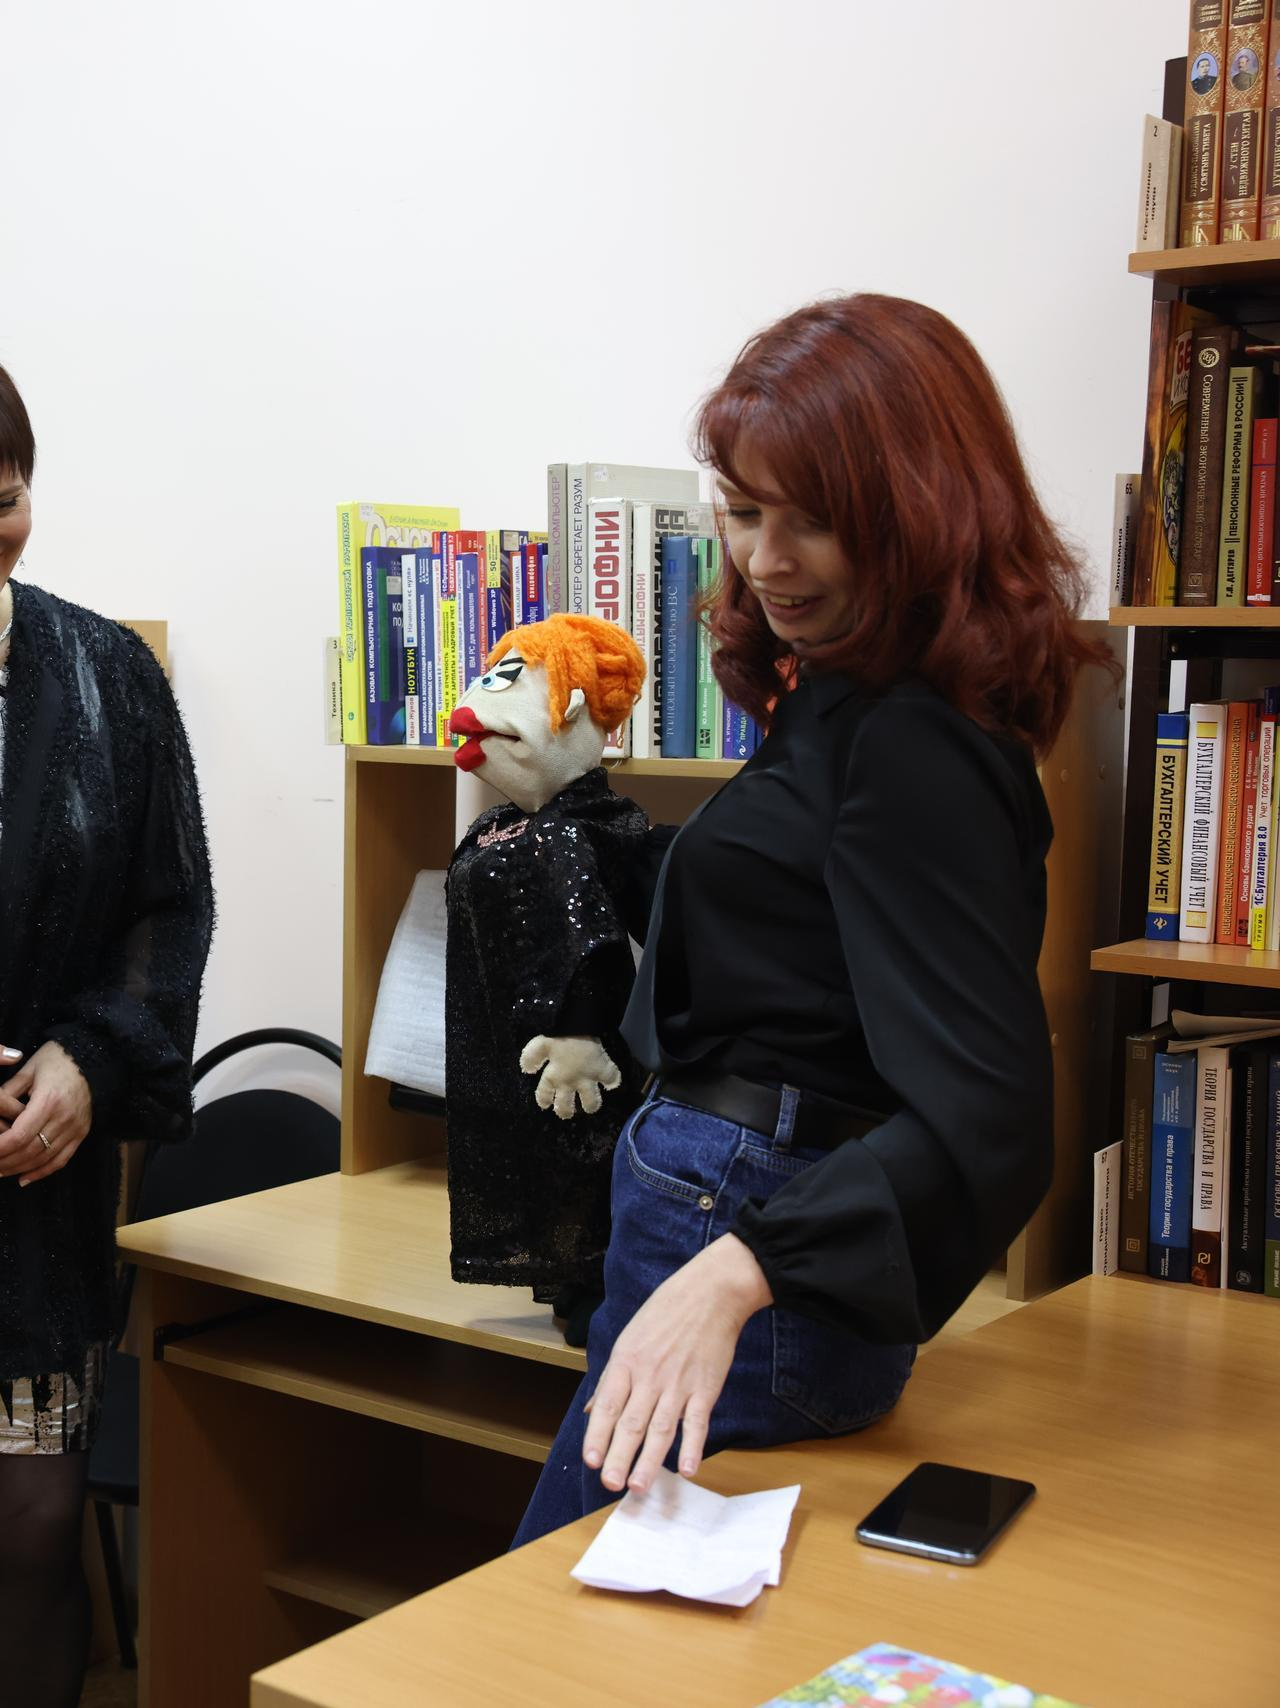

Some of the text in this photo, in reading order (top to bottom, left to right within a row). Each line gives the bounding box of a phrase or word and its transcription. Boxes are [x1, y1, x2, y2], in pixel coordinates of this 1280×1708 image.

[1153, 125, 1158, 137] 2
[1202, 122, 1211, 151] ТИБЕТА
[1230, 142, 1239, 163] СТЕН
[1200, 151, 1209, 185] СВЯТЫНЬ
[1238, 112, 1251, 196] НЕДВИЖНОГО КИТАЯ
[1234, 382, 1246, 421] РОССИИ
[1233, 432, 1243, 474] РЕФОРМЫ
[551, 476, 561, 545] КОМПЬЮТЕР
[1230, 475, 1241, 537] ПЕНСИОННЫЕ
[489, 560, 497, 572] 50
[573, 478, 583, 614] ЬЮТЕР ОБРЕТАЕТ РАЗУМ
[592, 510, 620, 621] ИНФОР
[1114, 528, 1123, 591] Экономика
[366, 561, 374, 608] ПОДГОТОВКА
[490, 589, 496, 600] XP
[670, 585, 678, 605] ВС
[636, 573, 646, 655] ИНФОРМАТИ
[468, 632, 476, 645] для
[468, 645, 476, 656] PC
[406, 648, 416, 695] НОУТБУК
[468, 656, 476, 668] IBM
[739, 715, 748, 741] ПРАВДА
[1259, 726, 1273, 819] Учет торговых операций
[1154, 754, 1176, 904] БУХГАЛТЕРСКИЙ УЧЕТ
[1188, 741, 1214, 908] БУХГАЛТЕРСКИЙ ФИНАНСОВЫЙ УЧЕТ
[1240, 804, 1254, 902] Основы банковского аудита
[1253, 826, 1267, 906] 1С:Бухгалтерия 8.0
[1221, 889, 1232, 936] ПРЕДПРИЯТИЯ
[1204, 1067, 1218, 1101] ТЕОРИЯ
[1166, 1134, 1175, 1157] права
[1201, 1106, 1217, 1165] ГОСУДАРСТВА
[1163, 1164, 1175, 1211] государства
[1200, 1182, 1213, 1210] ПРАВА
[1161, 1211, 1173, 1238] Теория
